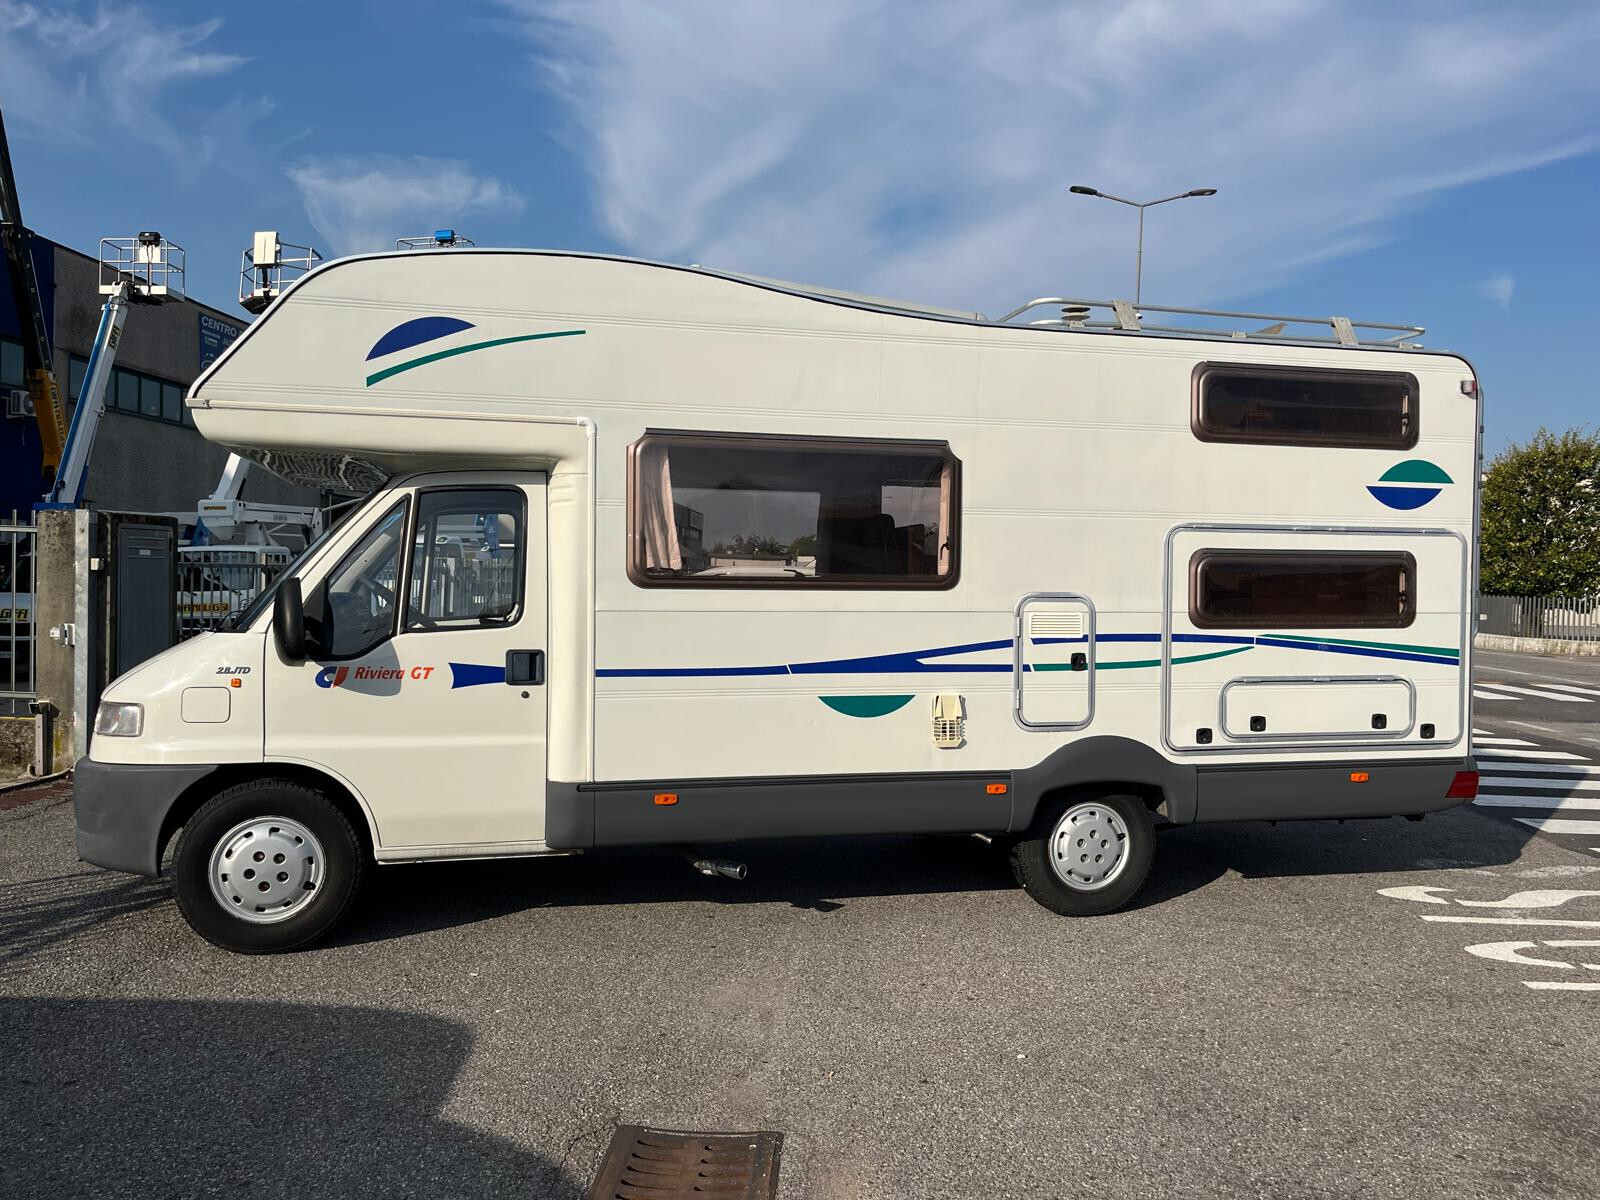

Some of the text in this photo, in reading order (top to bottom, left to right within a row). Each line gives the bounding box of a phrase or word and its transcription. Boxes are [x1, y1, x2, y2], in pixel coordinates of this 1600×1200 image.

[201, 316, 238, 338] CENTRO
[353, 666, 434, 680] Riviera GT
